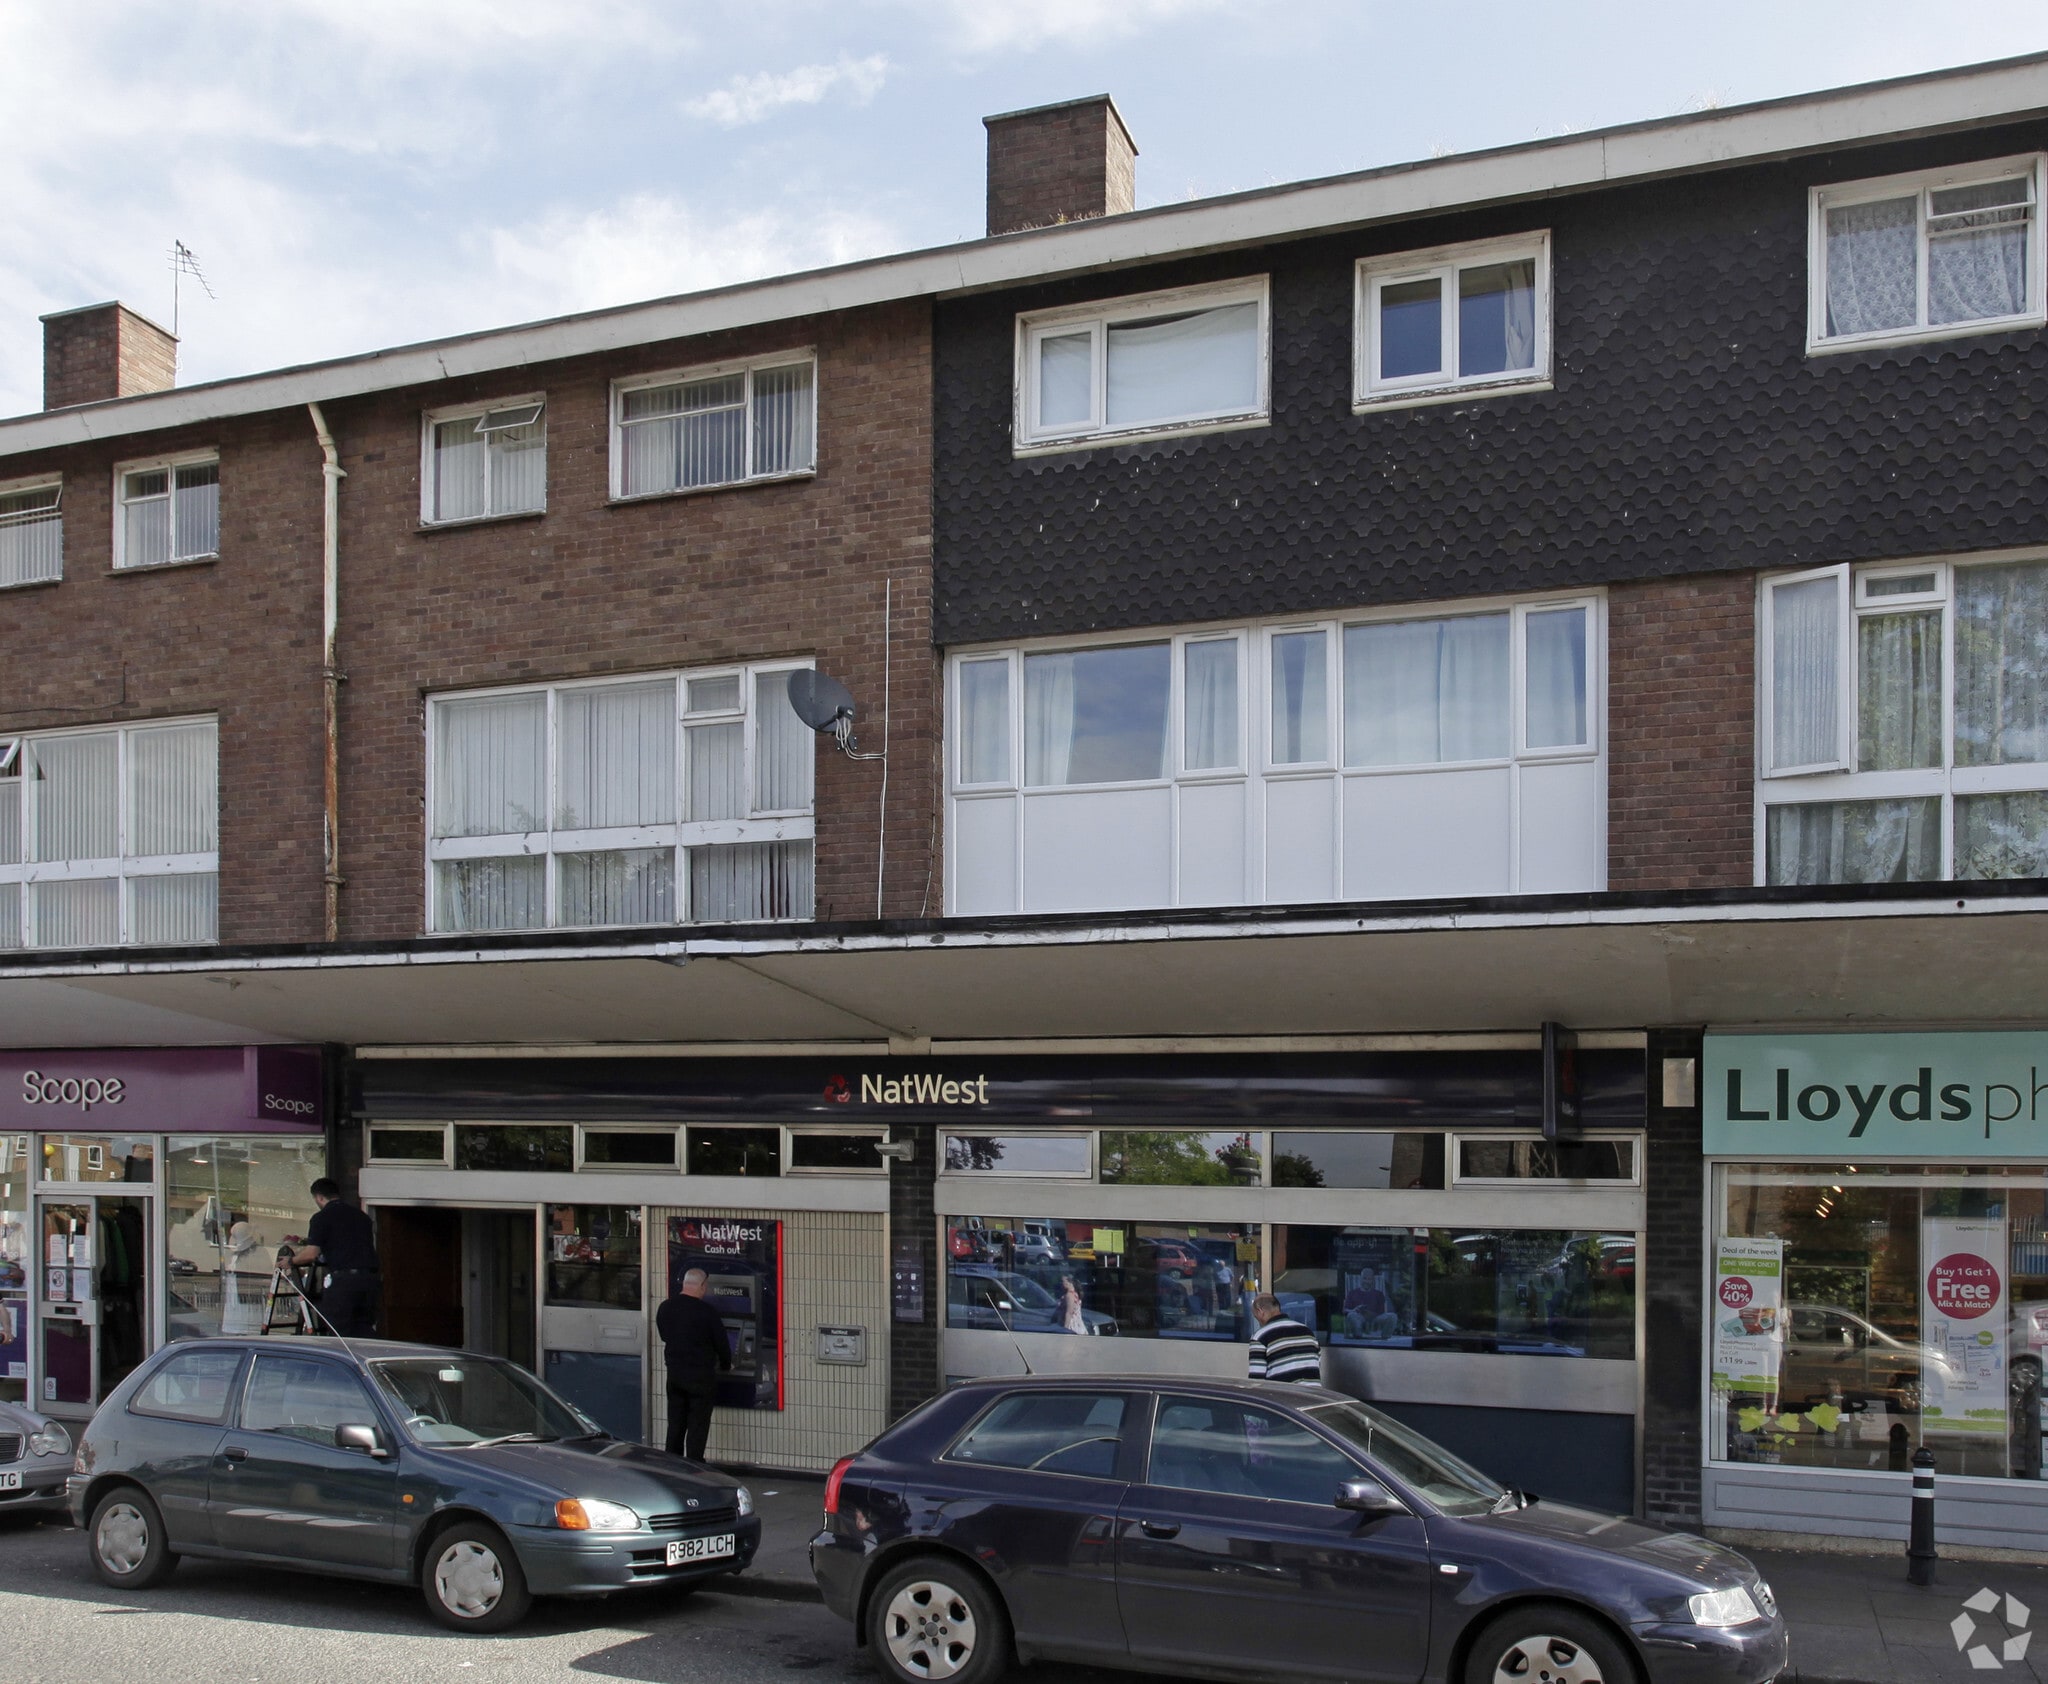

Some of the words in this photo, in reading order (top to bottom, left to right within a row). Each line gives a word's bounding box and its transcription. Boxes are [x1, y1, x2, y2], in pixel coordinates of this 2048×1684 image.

[22, 1070, 125, 1111] Scope
[861, 1073, 989, 1104] NatWest
[264, 1093, 315, 1115] Scope
[700, 1223, 762, 1241] NatWest
[704, 1244, 725, 1254] Cash
[726, 1245, 740, 1254] out
[1722, 1246, 1738, 1254] Deal
[1936, 1267, 1955, 1277] Buy
[1957, 1267, 1963, 1276] 1
[1965, 1267, 1983, 1276] Get
[1986, 1268, 1991, 1276] 1
[713, 1287, 743, 1296] NatWest
[1724, 1281, 1748, 1291] Save
[1936, 1278, 1991, 1300] Free
[1722, 1290, 1750, 1303] 40%
[1964, 1301, 1991, 1309] Match
[0, 1473, 17, 1487] TG
[669, 1539, 704, 1560] R982
[707, 1535, 734, 1554] LCH
